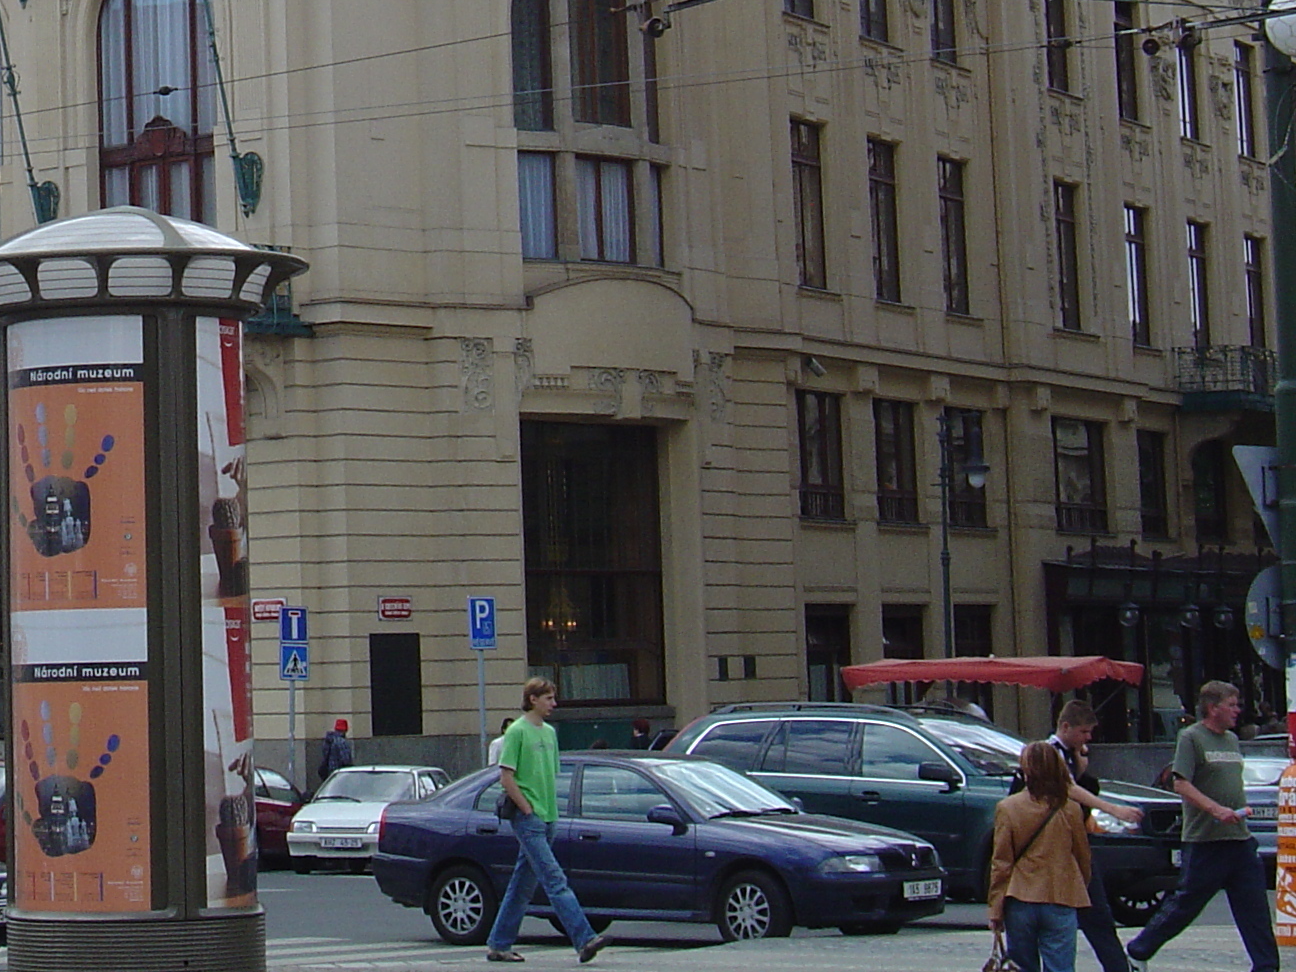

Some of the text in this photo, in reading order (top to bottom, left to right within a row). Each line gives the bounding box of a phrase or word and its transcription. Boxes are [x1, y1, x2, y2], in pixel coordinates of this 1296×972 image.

[29, 367, 134, 382] Národní muzeum
[475, 600, 490, 629] P
[34, 666, 140, 678] Národní muzeum
